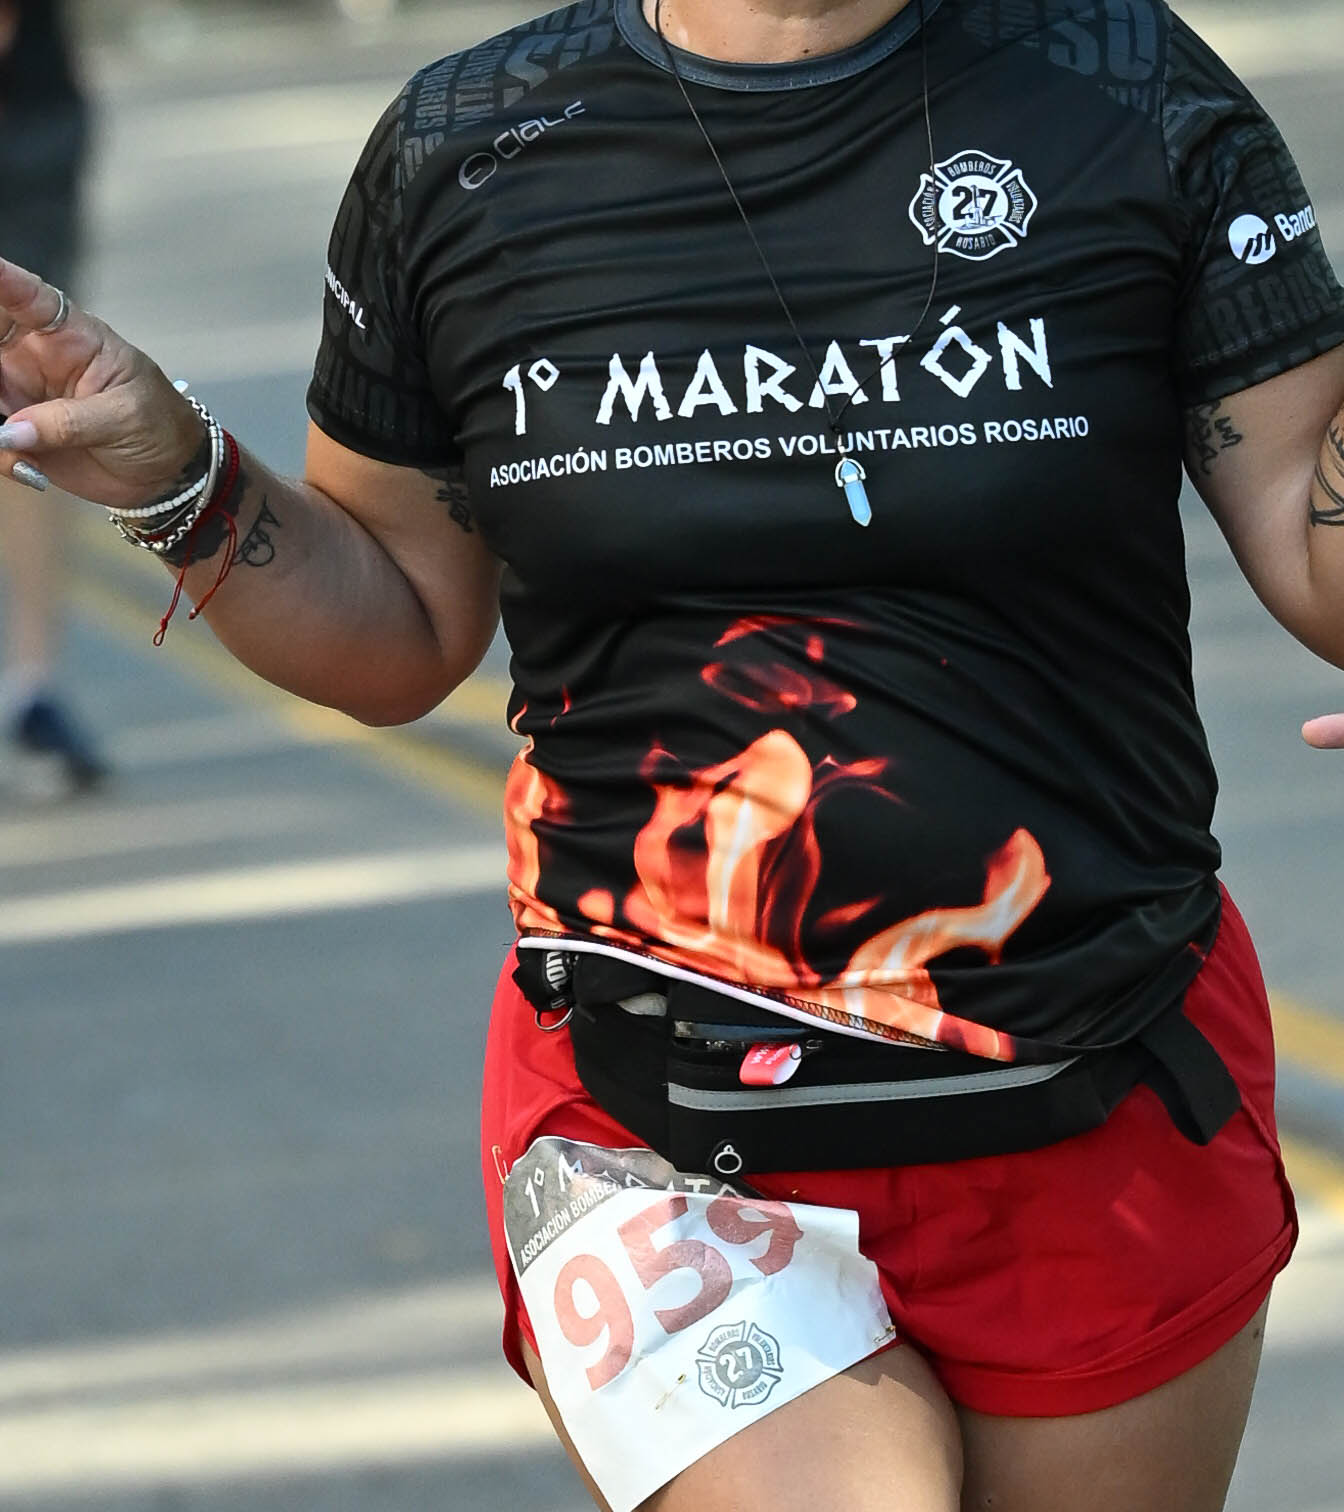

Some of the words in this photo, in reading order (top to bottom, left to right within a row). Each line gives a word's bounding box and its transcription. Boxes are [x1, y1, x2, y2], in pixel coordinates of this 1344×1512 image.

[947, 160, 997, 178] BOMBEROS
[952, 185, 998, 221] 27
[956, 234, 996, 250] ROSARIO
[596, 304, 1054, 425] MARATÓN
[490, 447, 607, 488] ASOCIACIÓN
[615, 438, 772, 469] BOMBEROS
[778, 423, 977, 457] VOLUNTARIOS
[983, 416, 1089, 444] ROSARIO
[554, 1193, 804, 1391] 959
[719, 1346, 753, 1383] 27
